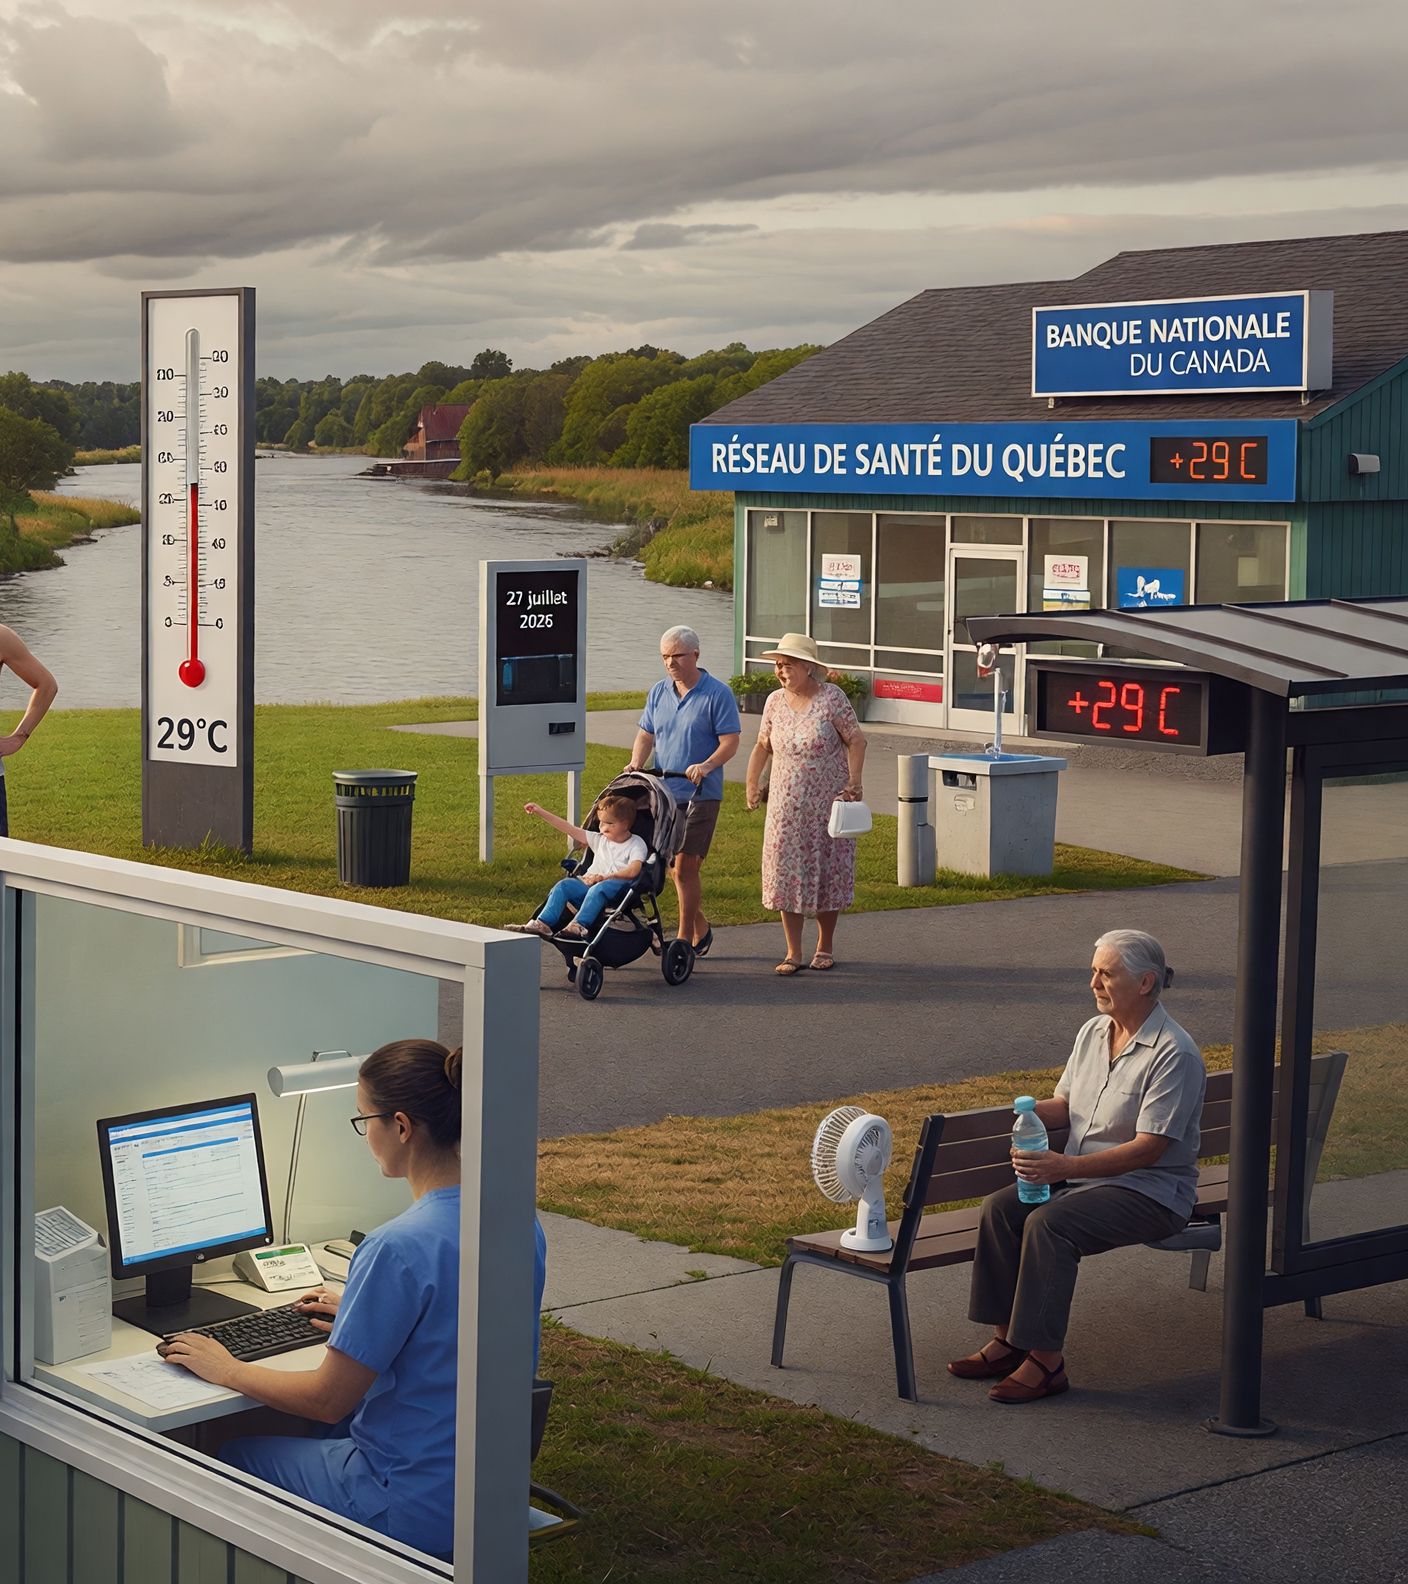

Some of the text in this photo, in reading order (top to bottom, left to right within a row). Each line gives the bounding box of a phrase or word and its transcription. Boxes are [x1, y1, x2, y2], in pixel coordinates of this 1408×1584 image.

[1046, 311, 1291, 350] BANQUE NATIONALE
[1130, 348, 1271, 377] DU CANADA
[712, 433, 1126, 483] RÉSEAU DE SANTÉ DU QUÉBEC
[1169, 441, 1230, 480] +29
[506, 589, 568, 610] 27 juillet
[215, 618, 224, 629] 0
[519, 614, 554, 629] 2026
[1067, 681, 1144, 732] +29
[157, 716, 228, 753] 29°C
